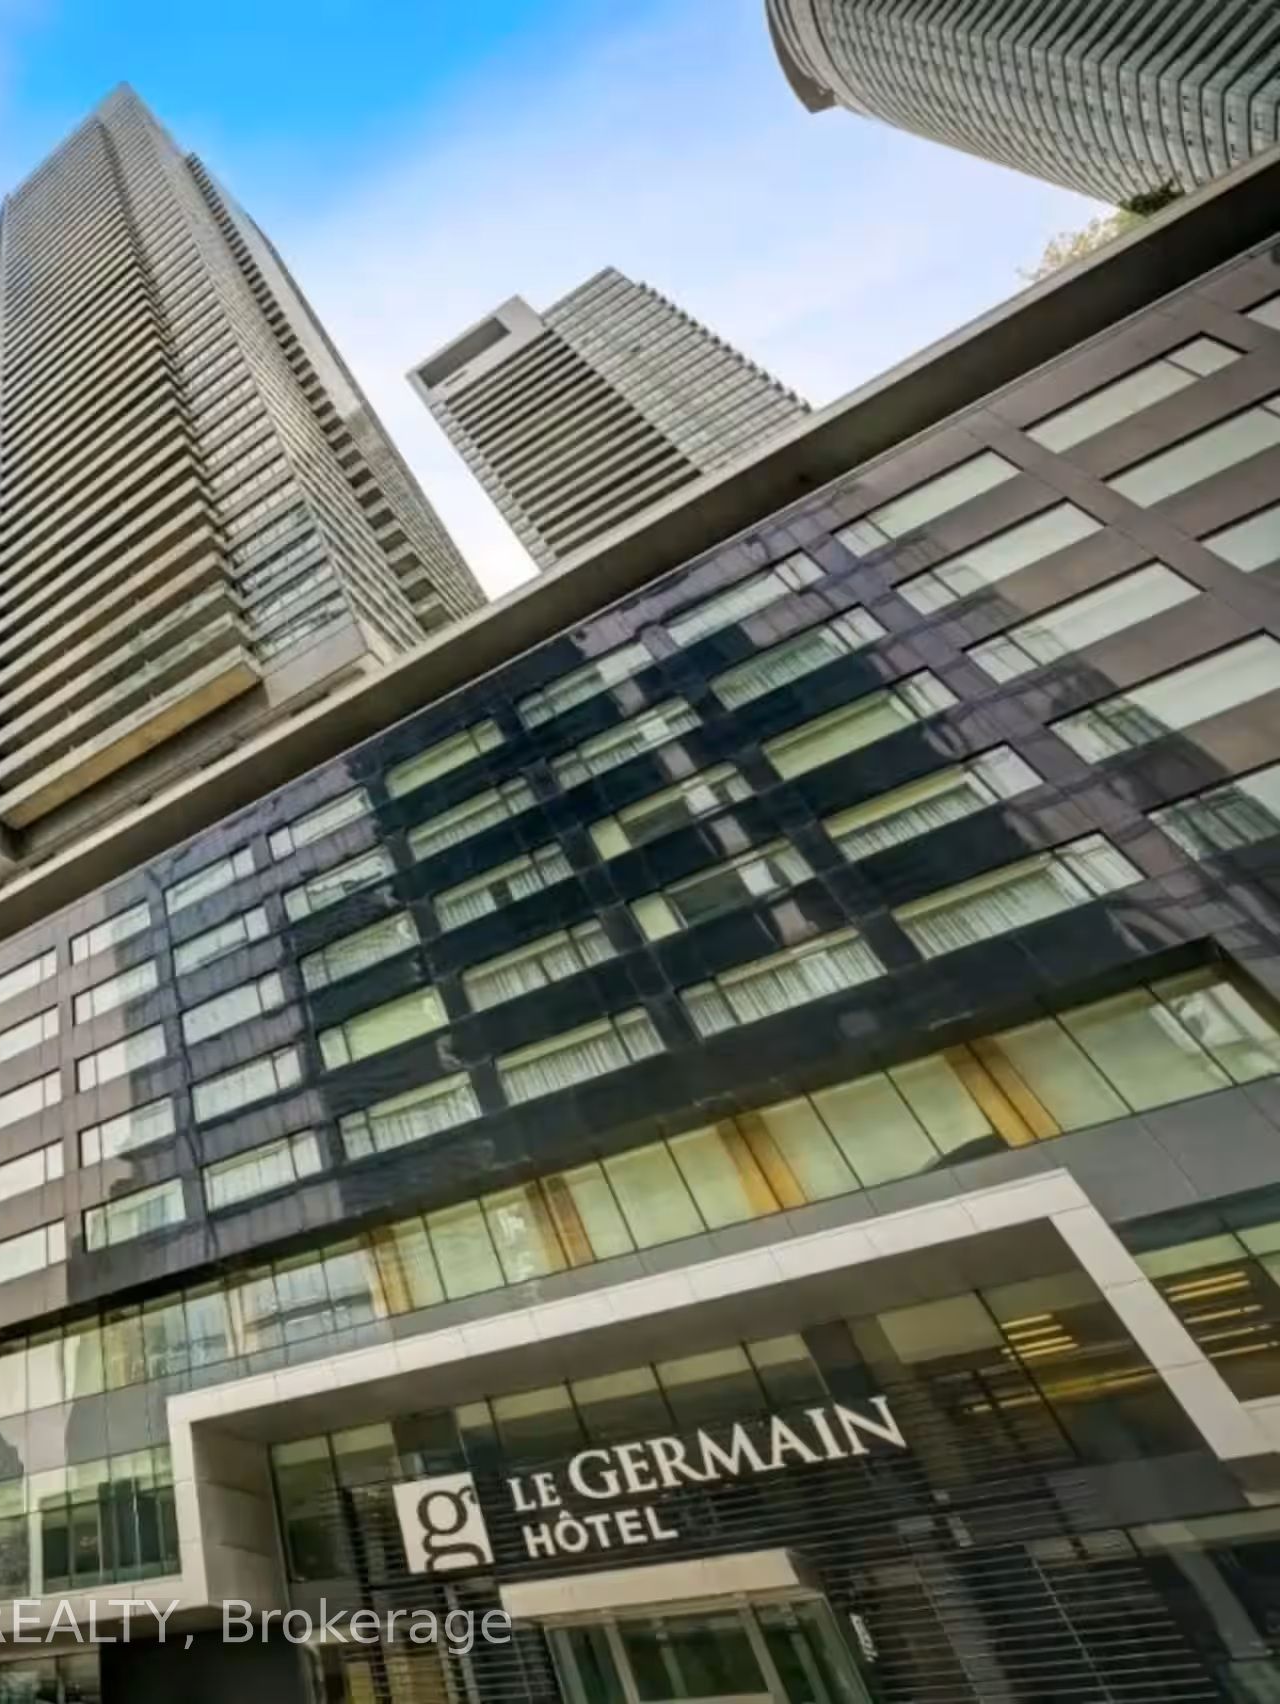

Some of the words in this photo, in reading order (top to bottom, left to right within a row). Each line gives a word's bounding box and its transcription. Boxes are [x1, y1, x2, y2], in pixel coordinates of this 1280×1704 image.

[507, 1473, 562, 1512] LE
[568, 1396, 907, 1499] GERMAIN
[522, 1506, 678, 1559] HÔTEL
